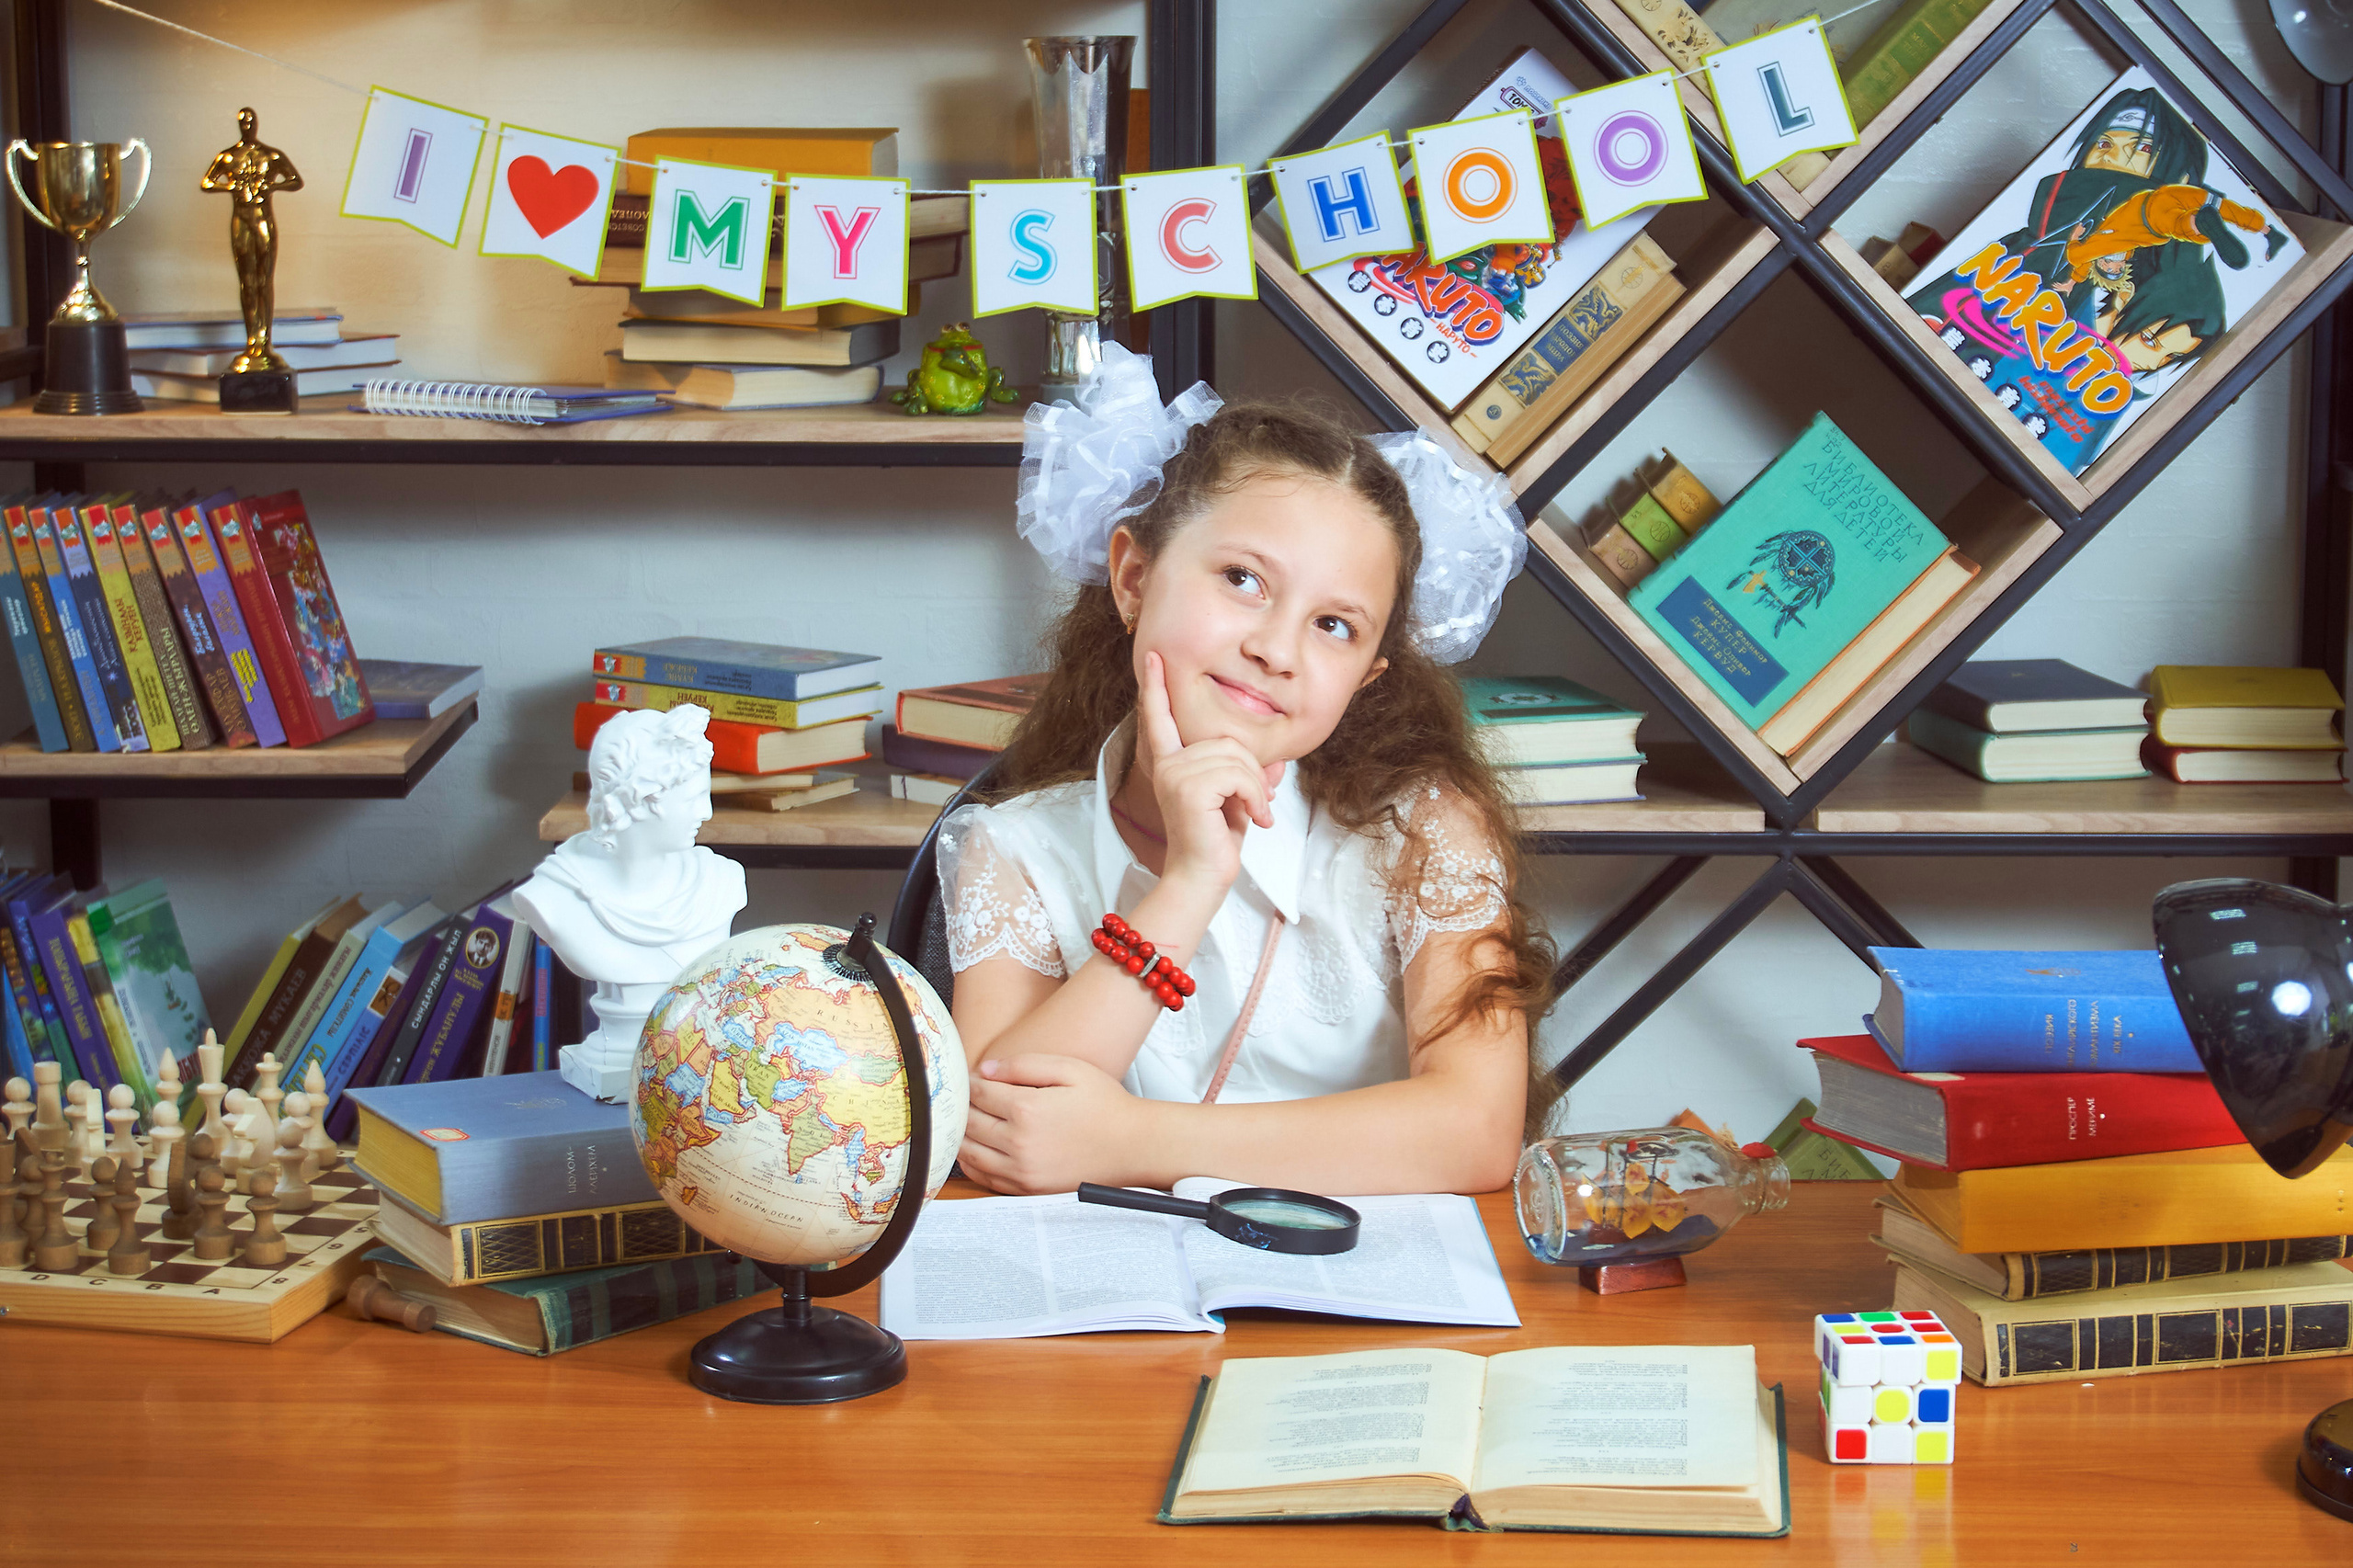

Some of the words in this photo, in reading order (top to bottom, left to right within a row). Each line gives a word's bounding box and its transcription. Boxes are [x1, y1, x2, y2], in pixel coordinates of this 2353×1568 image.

[393, 128, 432, 204] I
[1379, 242, 1505, 347] ARUTO
[1436, 322, 1471, 354] НАРУТО
[1955, 241, 2134, 417] NARUTO
[1544, 342, 1565, 362] МИРА
[1802, 458, 1907, 563] ЛИТЕРАТУРЫ
[1820, 439, 1927, 546] БИБЛИОТЕКА
[1824, 460, 1906, 543] МИРОВОЙ
[1802, 476, 1836, 511] ДЛЯ
[1833, 506, 1889, 563] ДЕТЕЙ
[125, 603, 144, 642] КЕРУЕН
[1710, 619, 1748, 655] КУПЕР
[1692, 630, 1737, 675] КЕРВУД
[676, 692, 707, 703] КЕРУЕН
[409, 971, 443, 1029] СЫНДАРЛЫ
[437, 955, 449, 971] ОН
[444, 928, 463, 955] ЖЫЛ
[816, 1009, 889, 1029] RUSSIA
[748, 1062, 770, 1080] IRAN
[2068, 1096, 2077, 1139] ПРОСПЕР
[2086, 1096, 2097, 1135] МЕРИМЕ
